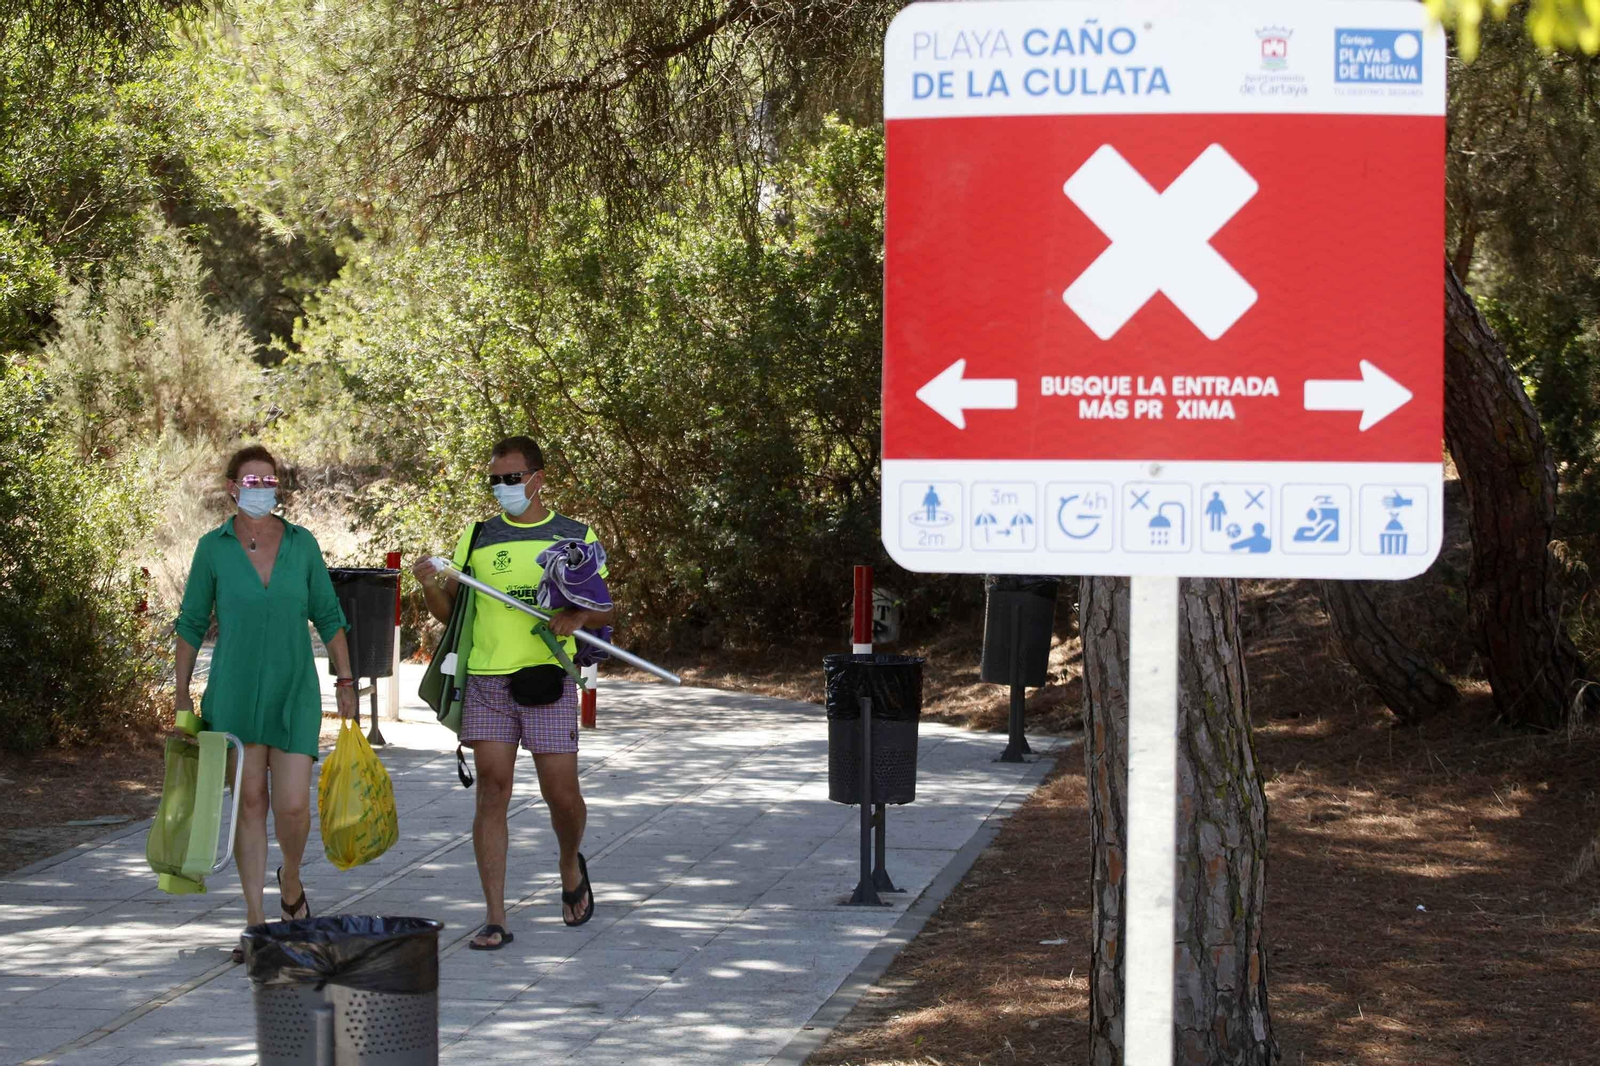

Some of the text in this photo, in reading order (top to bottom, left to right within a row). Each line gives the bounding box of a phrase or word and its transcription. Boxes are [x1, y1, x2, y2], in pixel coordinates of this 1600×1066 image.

[912, 19, 1137, 60] PLAYA CAÑO
[1339, 48, 1391, 64] PLAYAS
[1339, 64, 1418, 80] DE HUELVA
[912, 67, 1171, 100] DE LA CULATA
[1239, 82, 1308, 97] de Cartaya
[1041, 376, 1280, 397] BUSQUE LA ENTRADA
[1078, 394, 1129, 419] MÁS
[990, 489, 1018, 505] 3m
[1082, 492, 1108, 509] 4h
[917, 530, 945, 547] 2m
